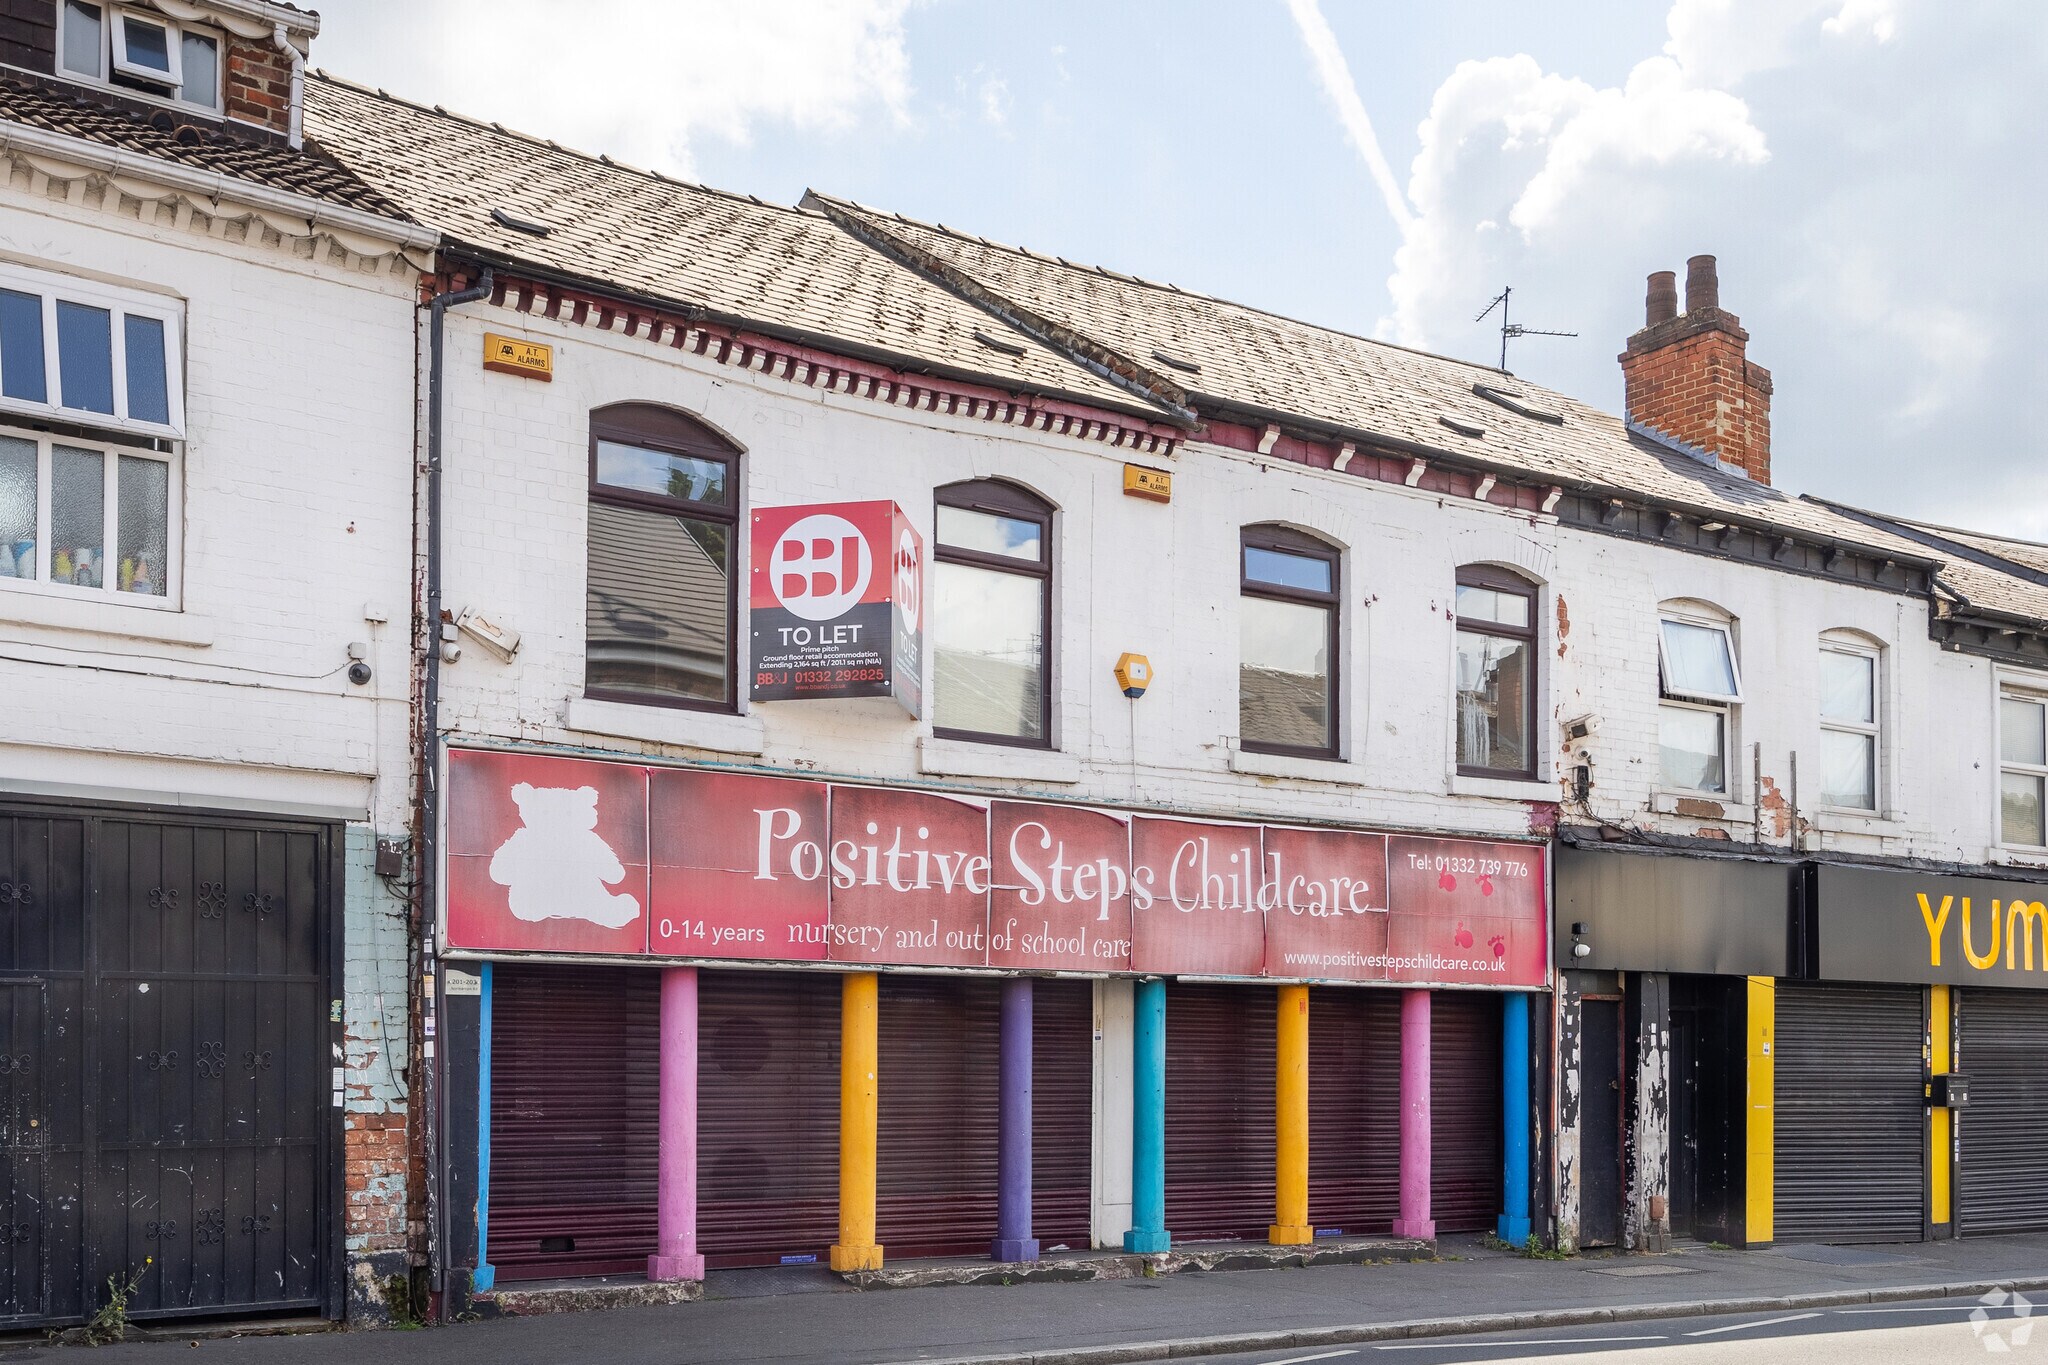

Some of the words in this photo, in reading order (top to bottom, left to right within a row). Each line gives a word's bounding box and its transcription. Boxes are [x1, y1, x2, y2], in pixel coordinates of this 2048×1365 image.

[526, 347, 539, 357] A.T.
[517, 355, 546, 368] ALARMS
[778, 626, 811, 646] TO
[820, 624, 863, 644] LET
[822, 646, 840, 654] pitch
[823, 651, 878, 660] accommodation
[759, 661, 792, 669] Extending
[756, 672, 788, 685] BB&J
[794, 670, 832, 683] 01332
[835, 668, 884, 682] 292825
[753, 807, 989, 894] Positive
[1008, 821, 1155, 920] Steps
[1170, 836, 1370, 918] Childcare
[1408, 854, 1432, 870] Tel:
[1436, 856, 1476, 874] 01332
[1479, 860, 1502, 876] 739
[1504, 862, 1528, 877] 776
[660, 918, 706, 939] 0-14
[712, 926, 766, 946] years
[788, 923, 889, 953] nursery
[896, 920, 938, 949] and
[946, 924, 984, 951] out
[992, 918, 1017, 952] of
[1022, 921, 1086, 956] school
[1094, 938, 1132, 959] care
[1284, 952, 1506, 973] www.positivestepschildcare.co.uk
